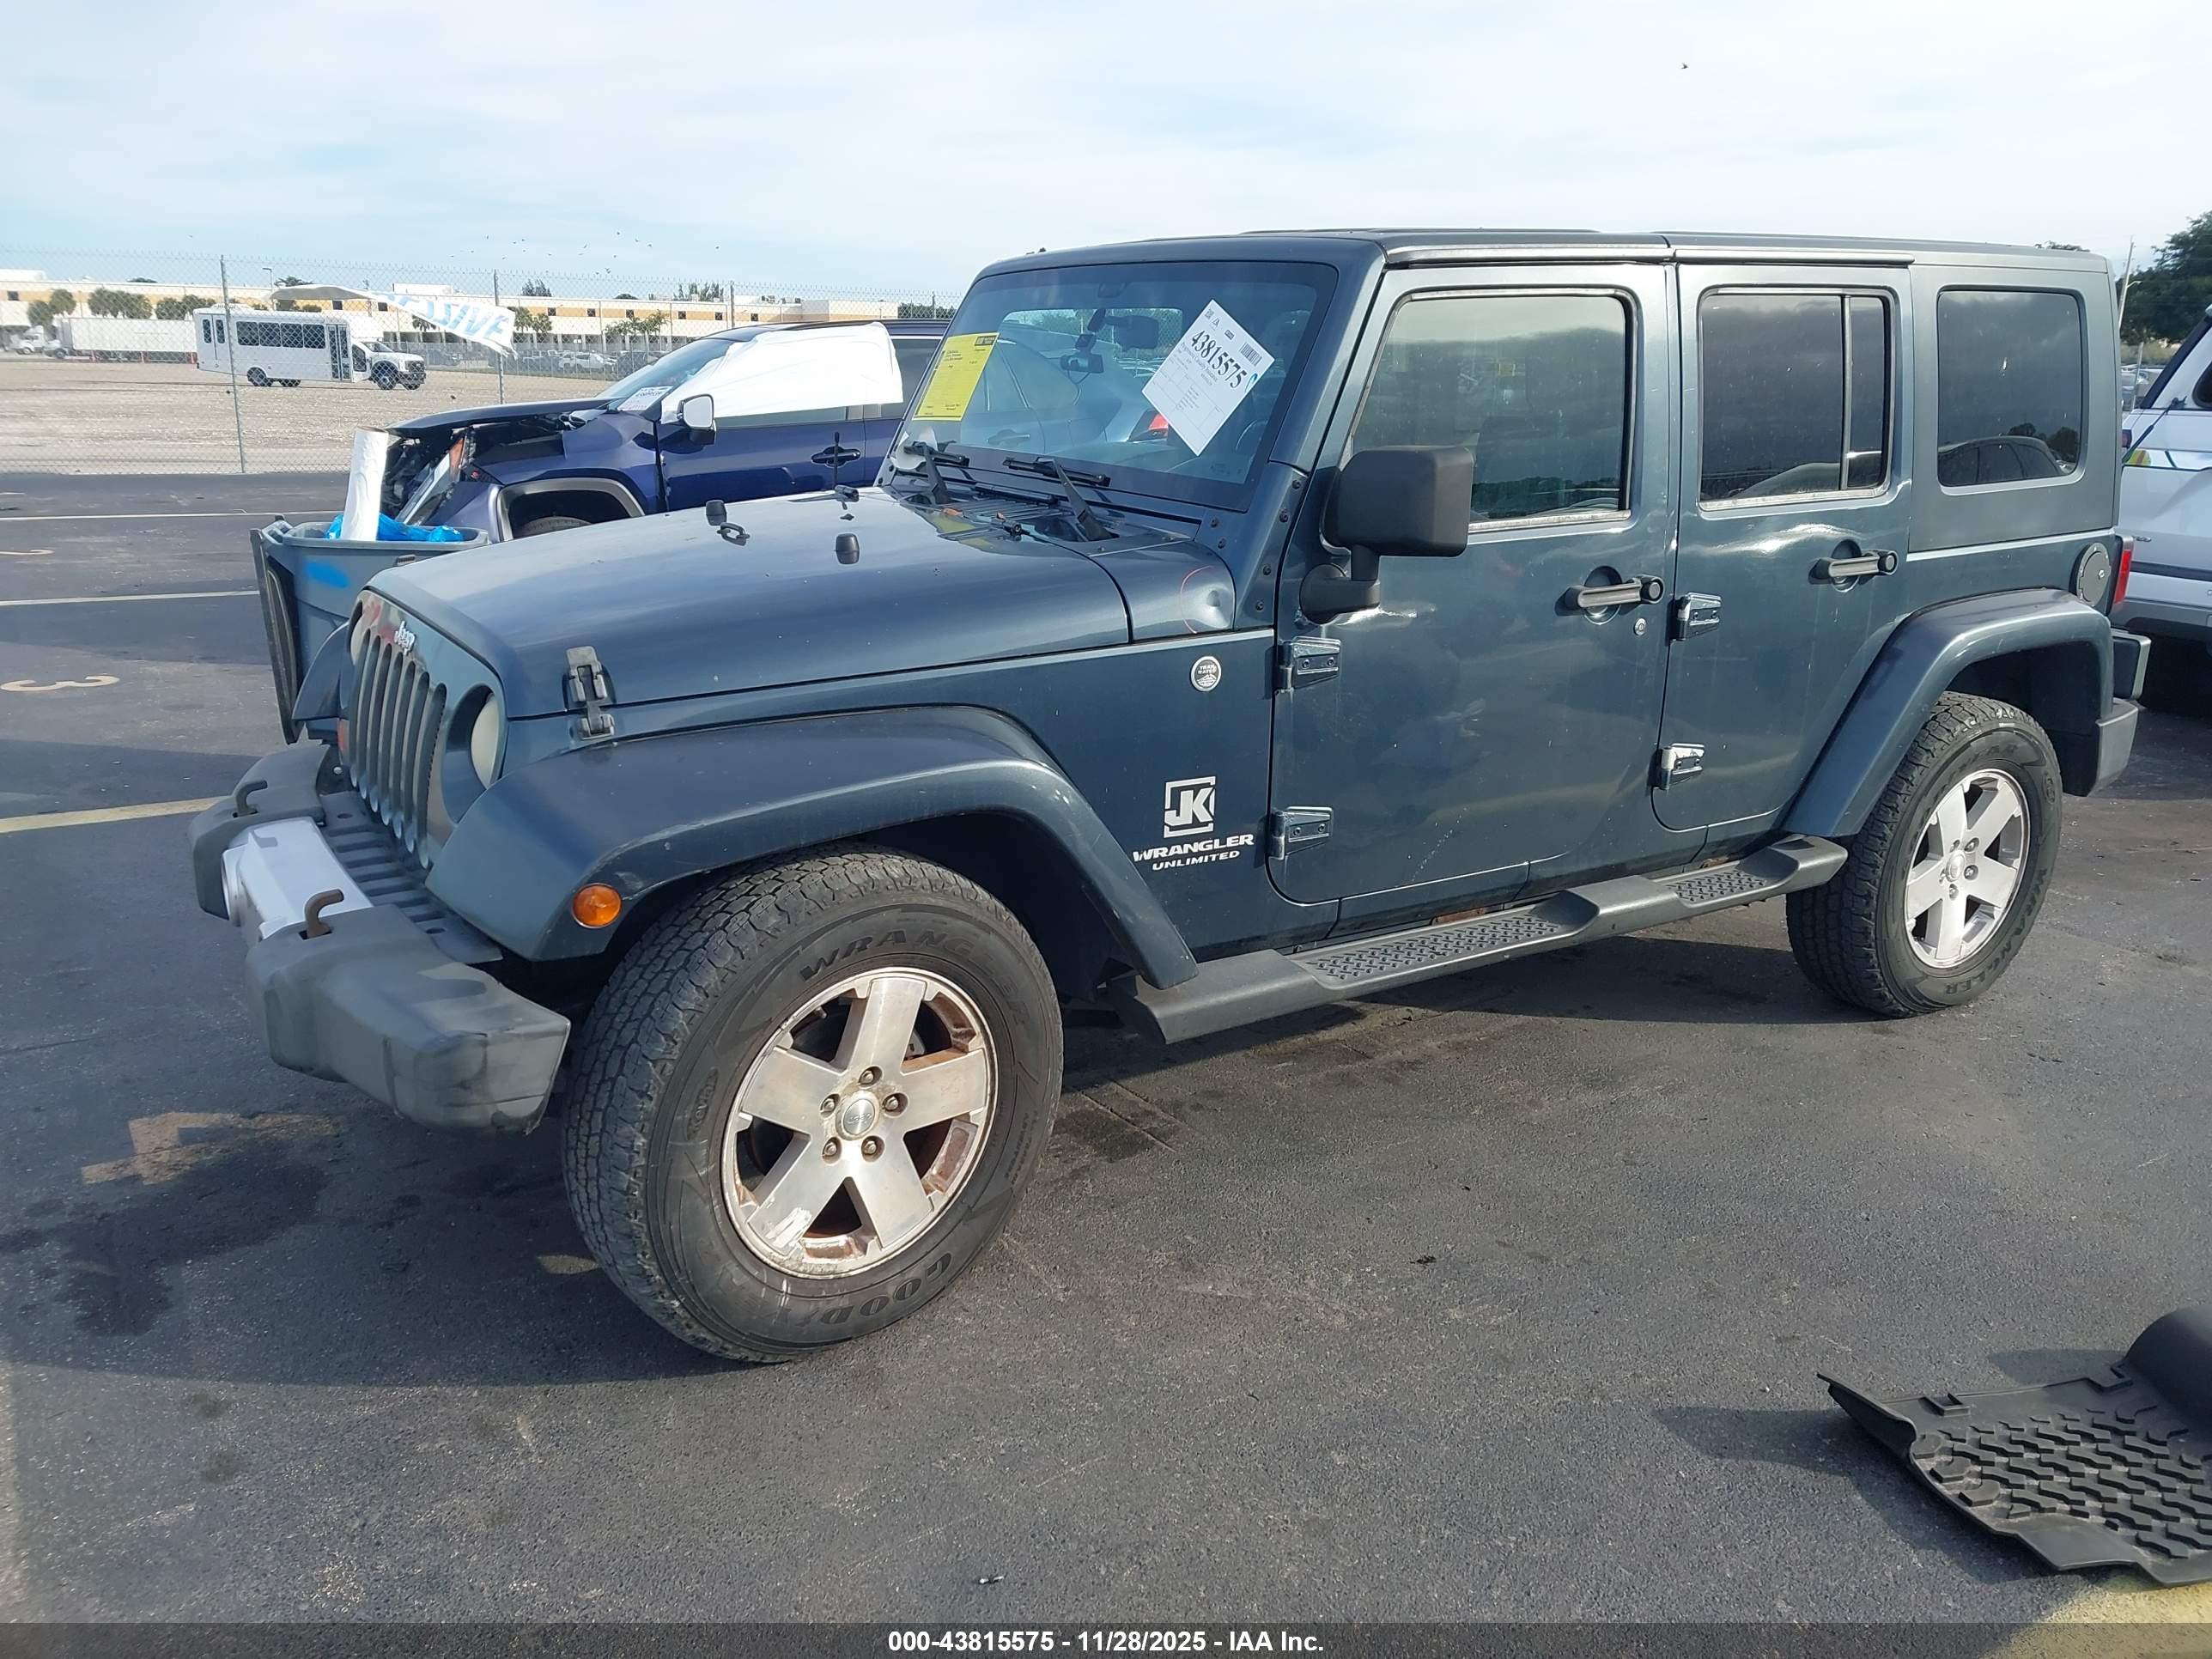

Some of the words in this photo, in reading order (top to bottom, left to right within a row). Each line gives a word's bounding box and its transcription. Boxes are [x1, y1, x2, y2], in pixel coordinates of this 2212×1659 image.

[1191, 330, 1248, 389] 43815575
[1164, 787, 1213, 826] JK
[1133, 834, 1255, 862] WRANGLER
[1152, 850, 1241, 871] UNLIMITED
